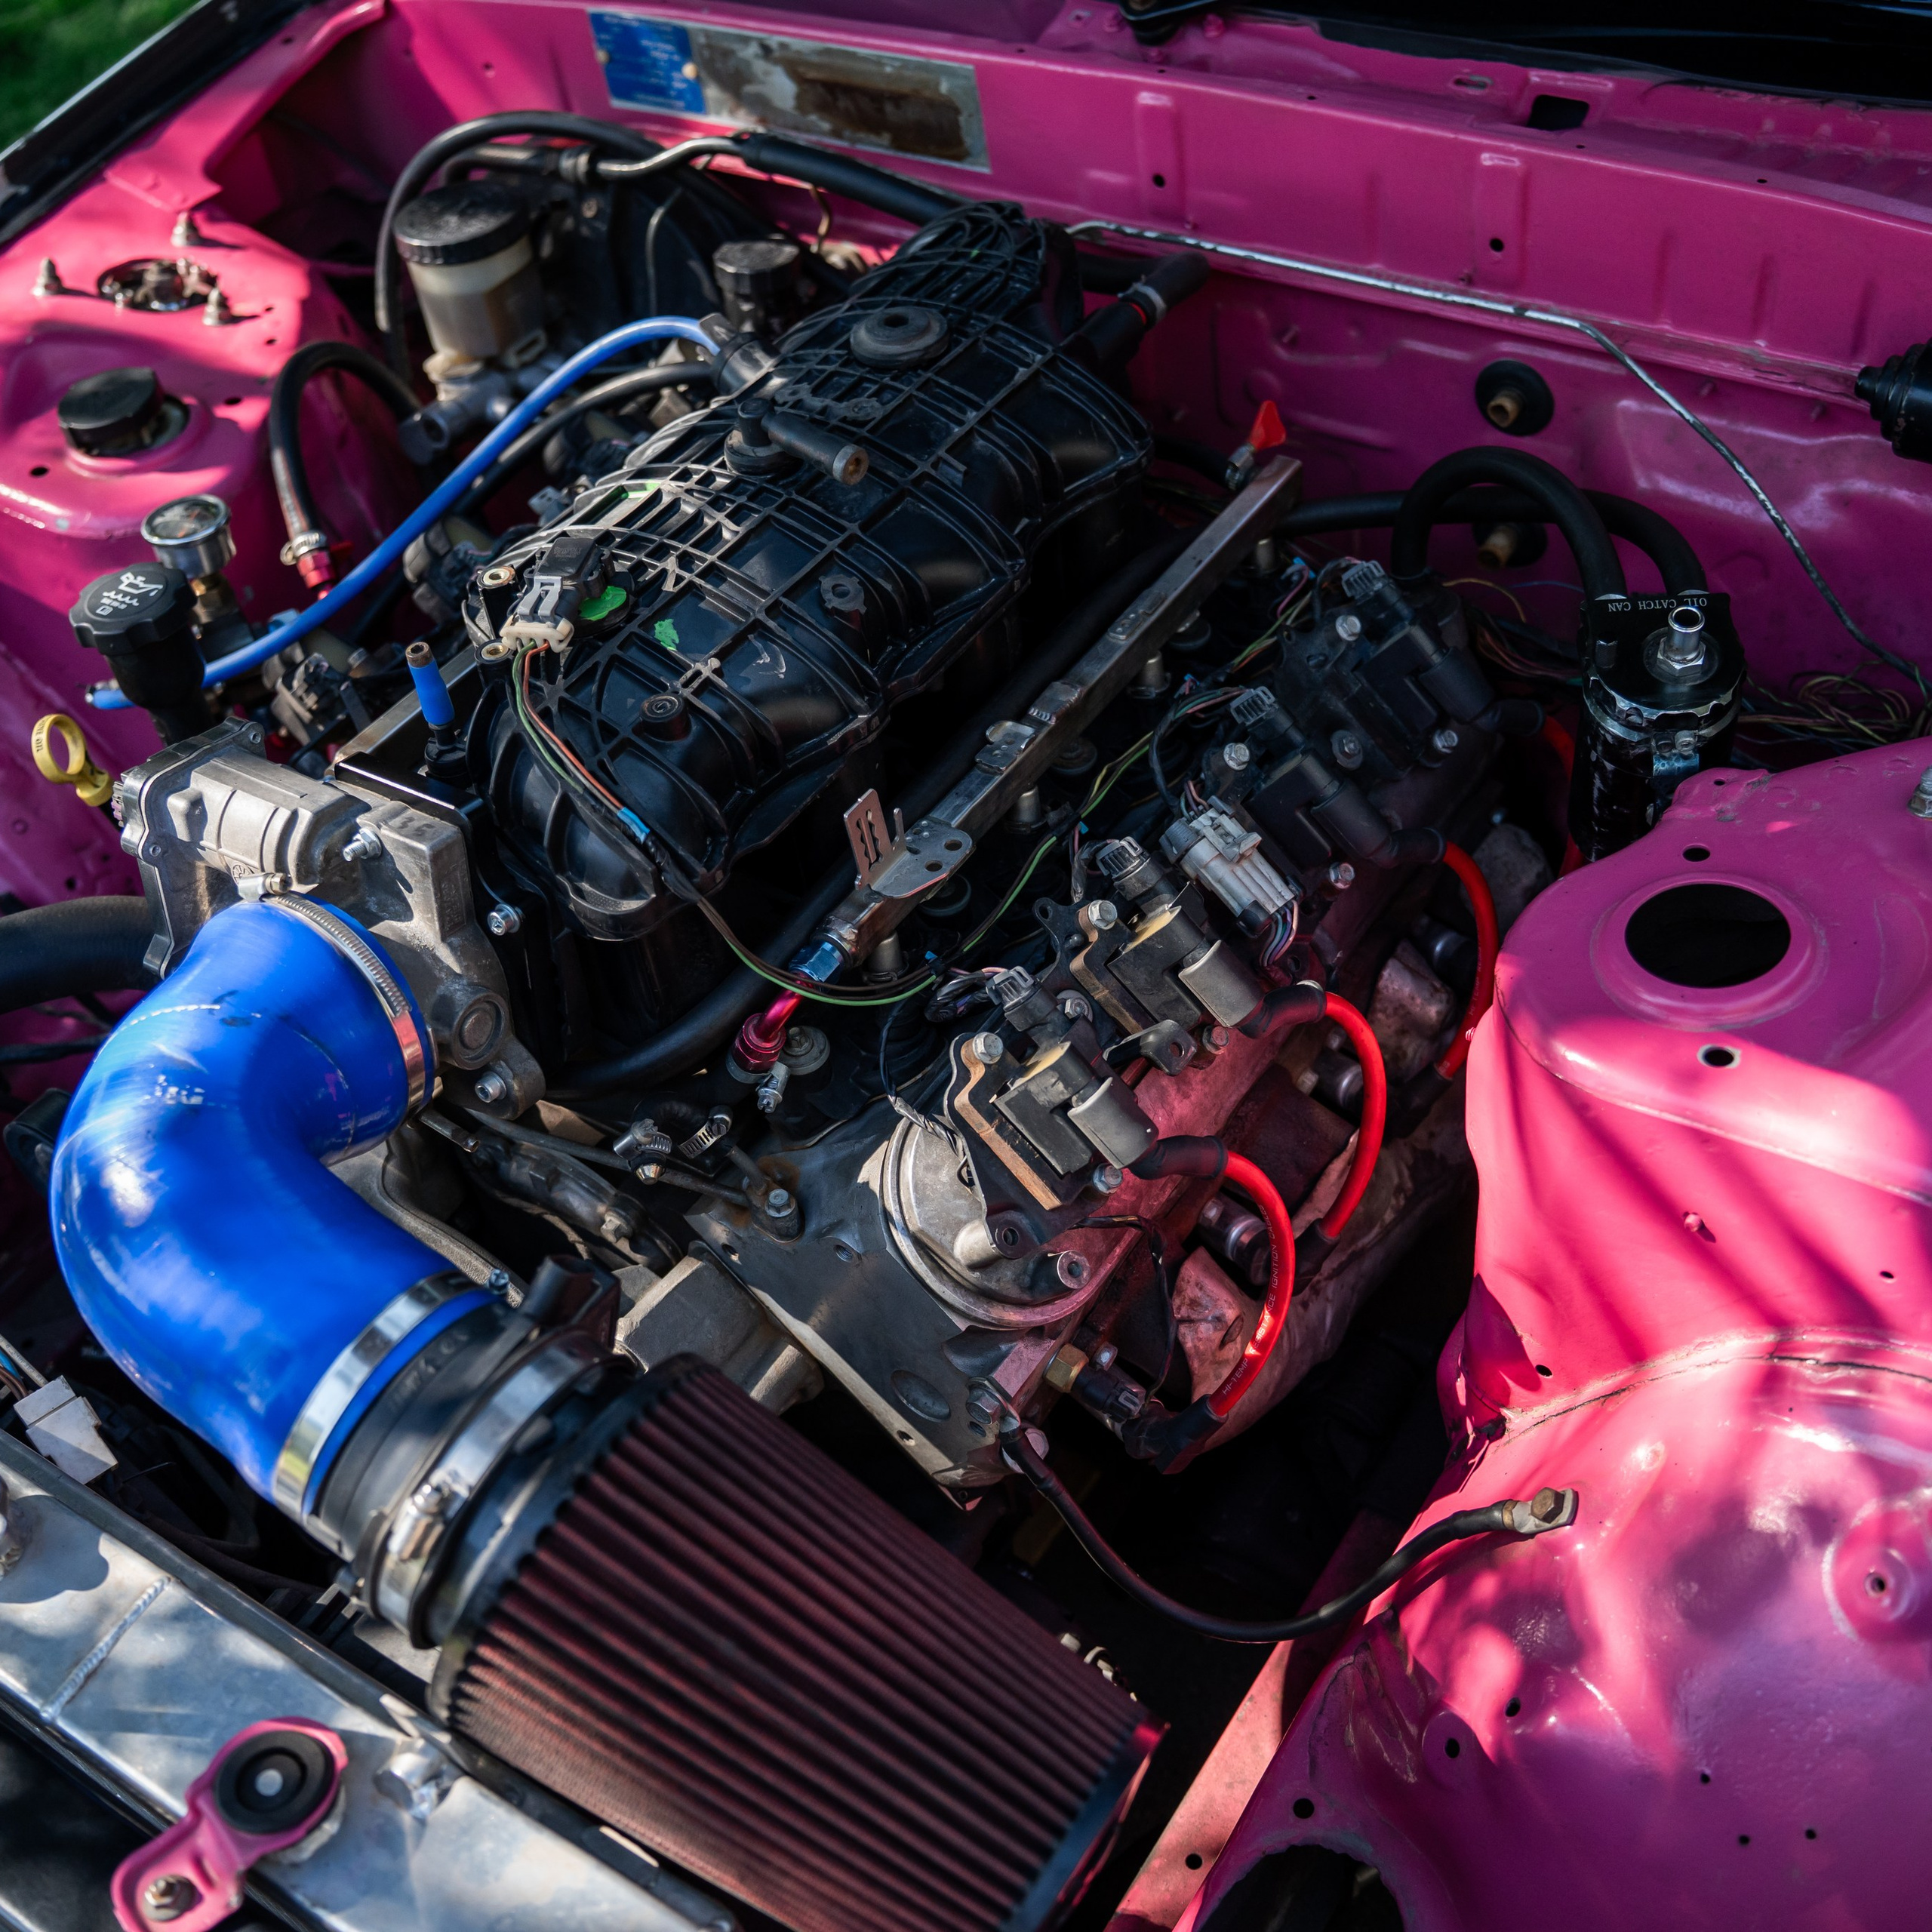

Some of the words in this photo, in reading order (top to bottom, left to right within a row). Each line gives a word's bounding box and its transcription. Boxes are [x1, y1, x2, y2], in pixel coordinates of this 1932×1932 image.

[1607, 601, 1632, 612] CAN
[1638, 599, 1677, 611] CATCH
[1684, 598, 1707, 607] OIL
[35, 739, 44, 752] OIL
[1222, 1358, 1248, 1395] HI-TEMP
[1249, 1293, 1276, 1355] RESISTANCE
[1270, 1244, 1279, 1289] IGNITION
